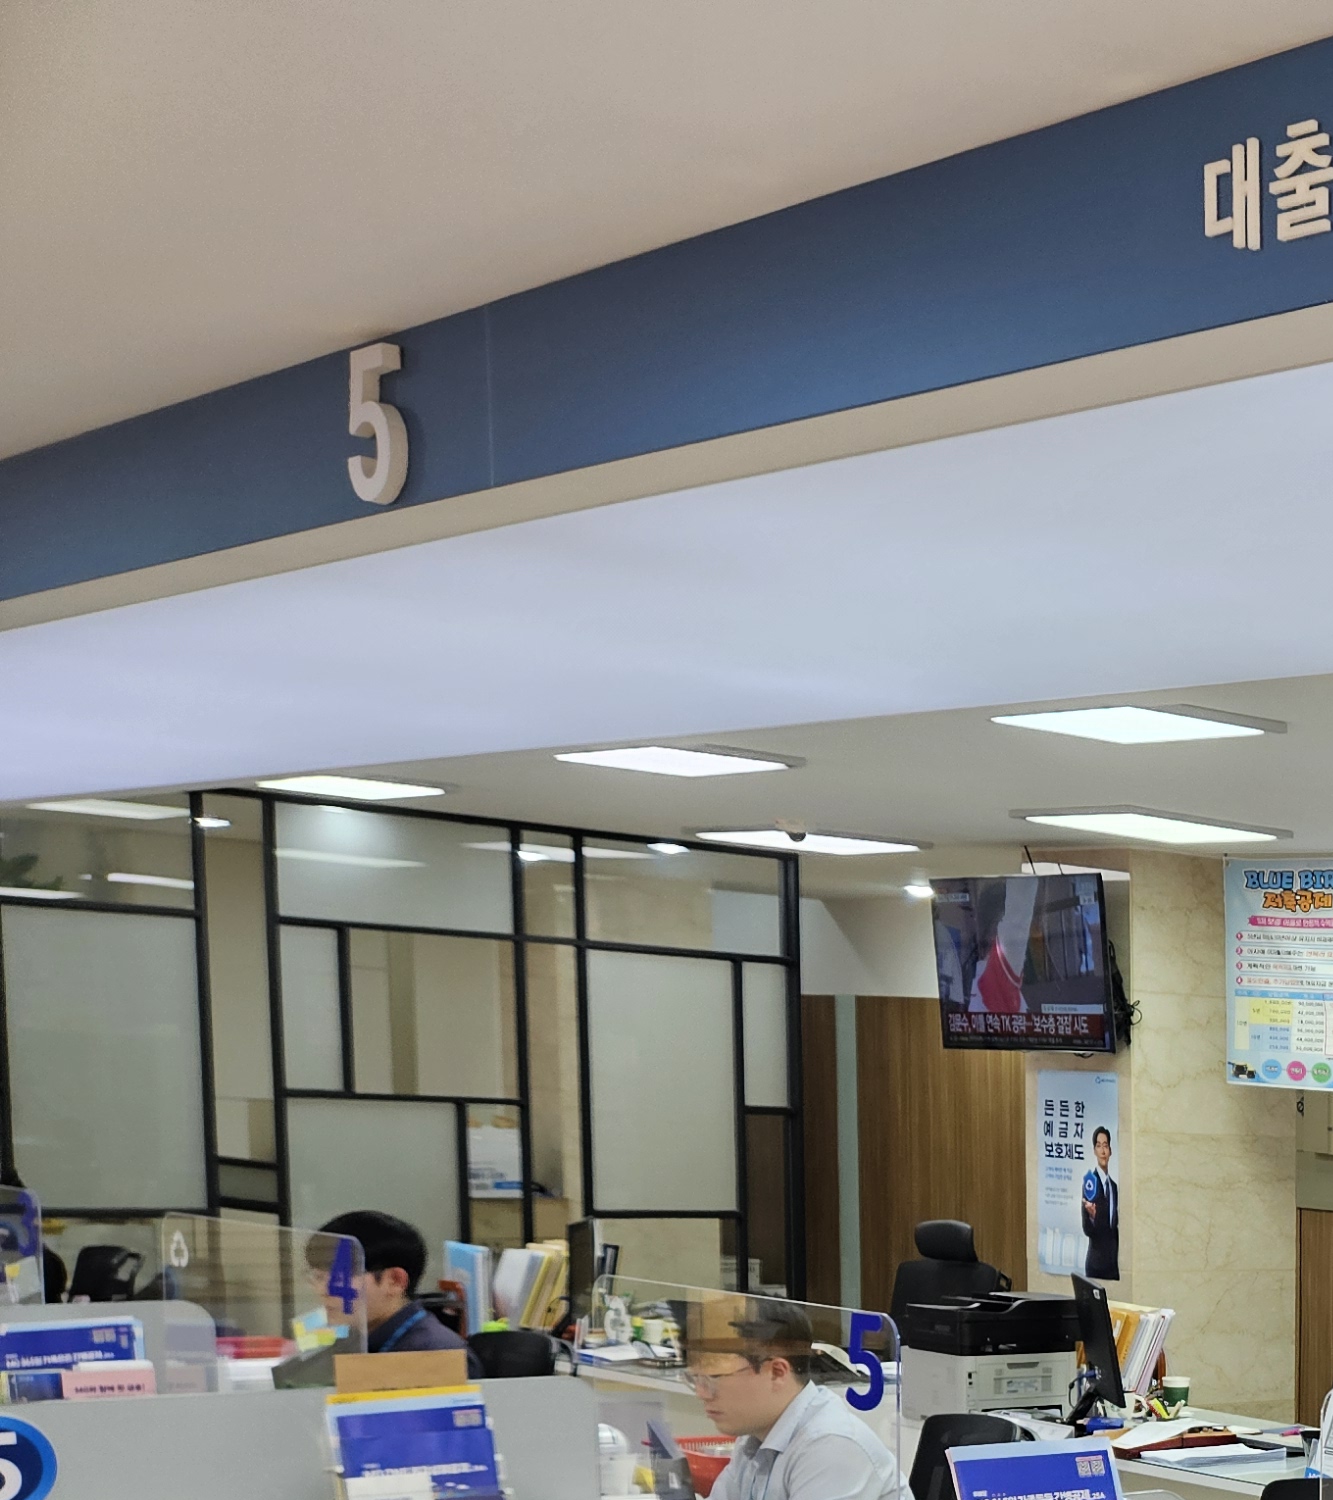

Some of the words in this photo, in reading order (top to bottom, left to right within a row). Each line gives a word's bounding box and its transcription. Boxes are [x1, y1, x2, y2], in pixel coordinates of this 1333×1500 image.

[347, 342, 409, 505] 5
[1244, 870, 1295, 889] BLUE
[1001, 1016, 1011, 1031] TK
[1074, 1016, 1089, 1034] 시도
[1045, 1141, 1085, 1160] 보호제도
[328, 1236, 360, 1315] 4
[845, 1312, 884, 1411] 5
